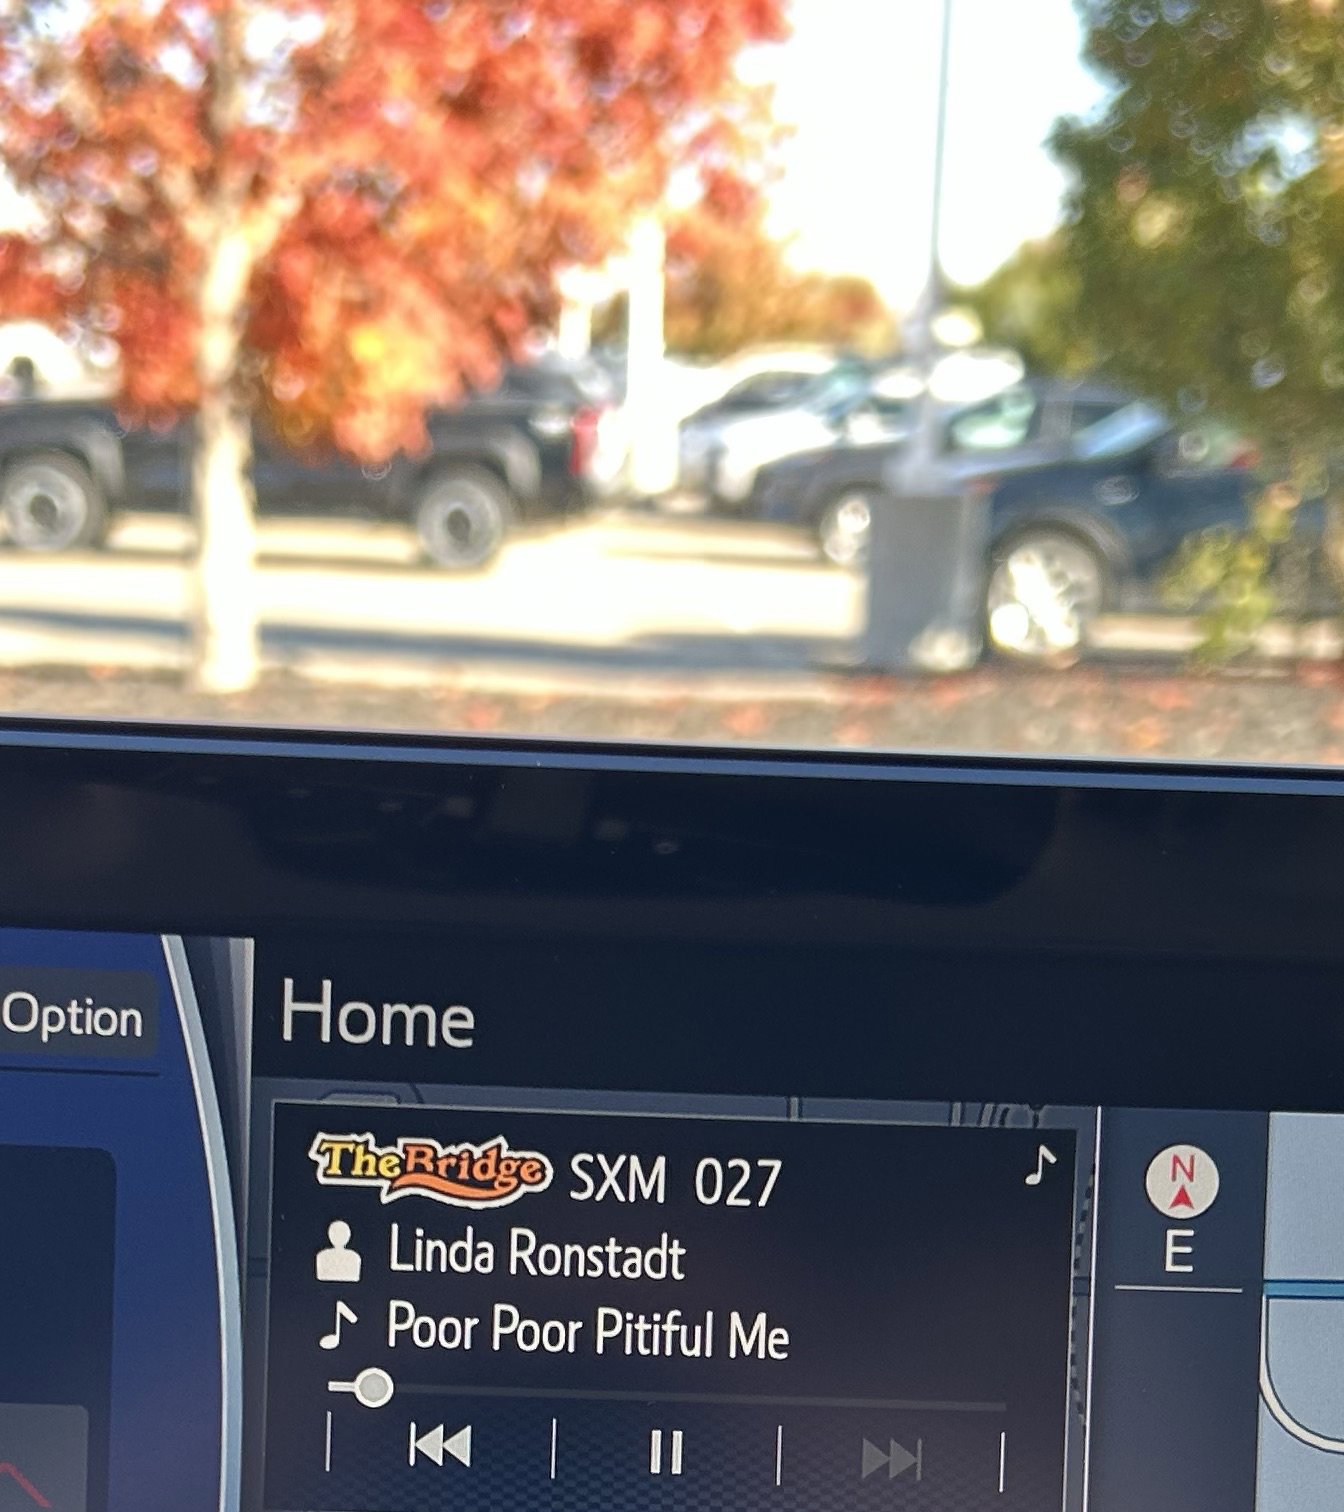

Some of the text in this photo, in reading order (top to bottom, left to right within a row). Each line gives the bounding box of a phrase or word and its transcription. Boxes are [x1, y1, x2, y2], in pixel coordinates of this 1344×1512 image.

[1, 990, 143, 1043] Option
[281, 977, 476, 1049] Home
[569, 1152, 783, 1208] SXM 027
[1170, 1153, 1196, 1183] N
[389, 1222, 687, 1281] Linda Ronstadt
[1164, 1228, 1196, 1273] E
[387, 1298, 790, 1361] Poor Poor Pitiful Me
